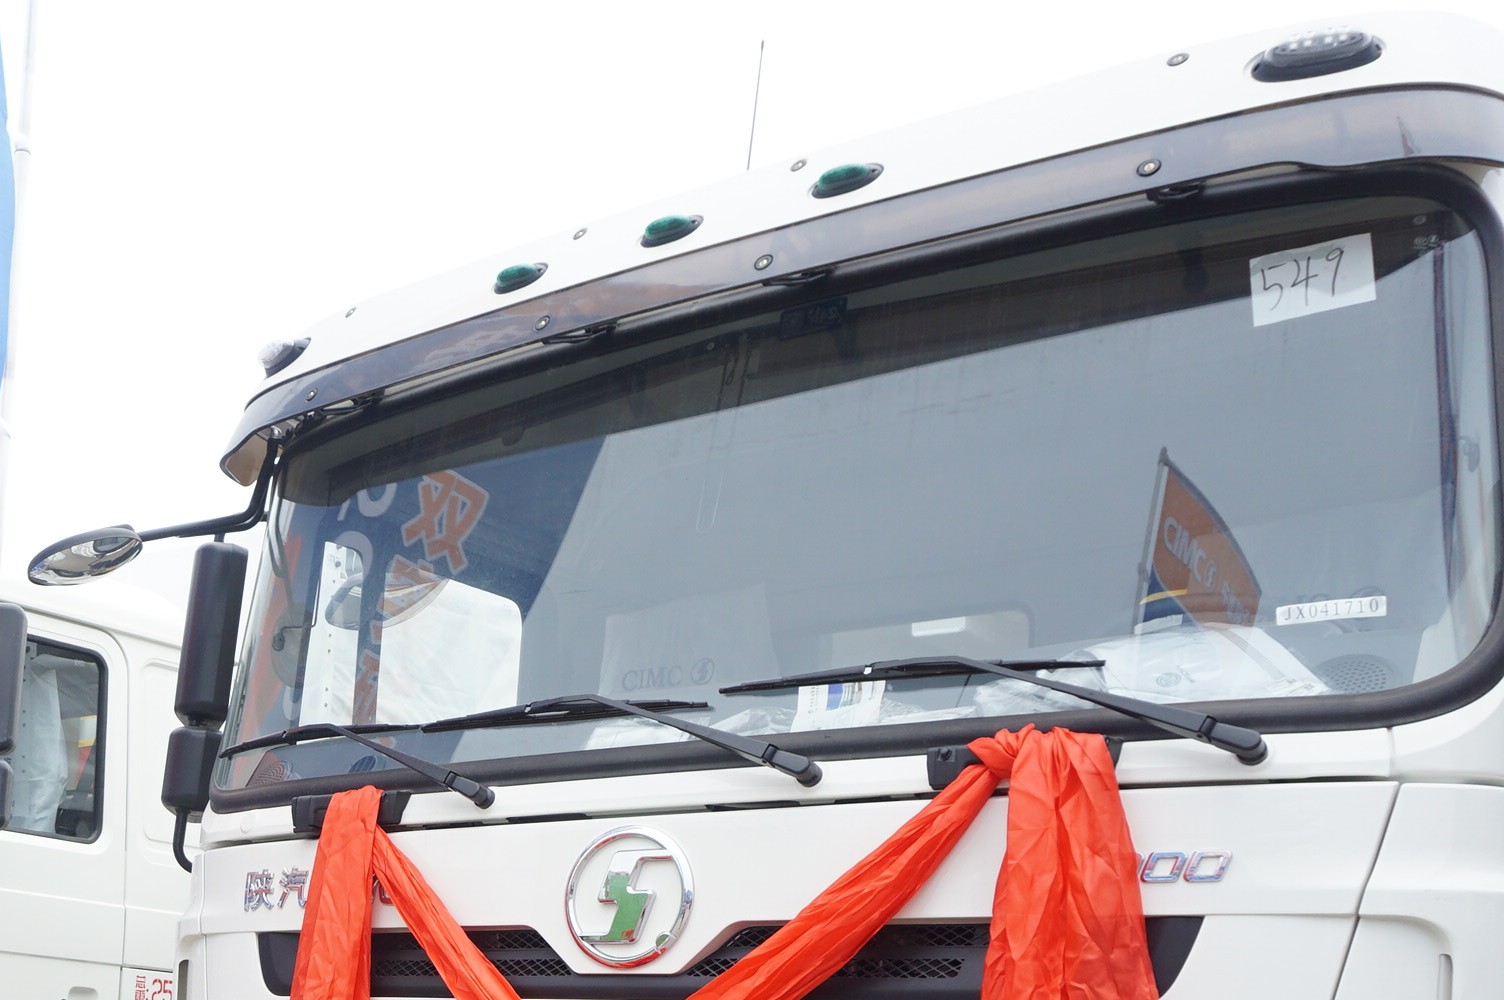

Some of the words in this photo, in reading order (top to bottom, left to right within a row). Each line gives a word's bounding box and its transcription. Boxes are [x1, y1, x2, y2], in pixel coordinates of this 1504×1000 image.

[1260, 247, 1344, 311] 549
[1284, 598, 1379, 621] JX041710
[622, 665, 683, 692] CIMC
